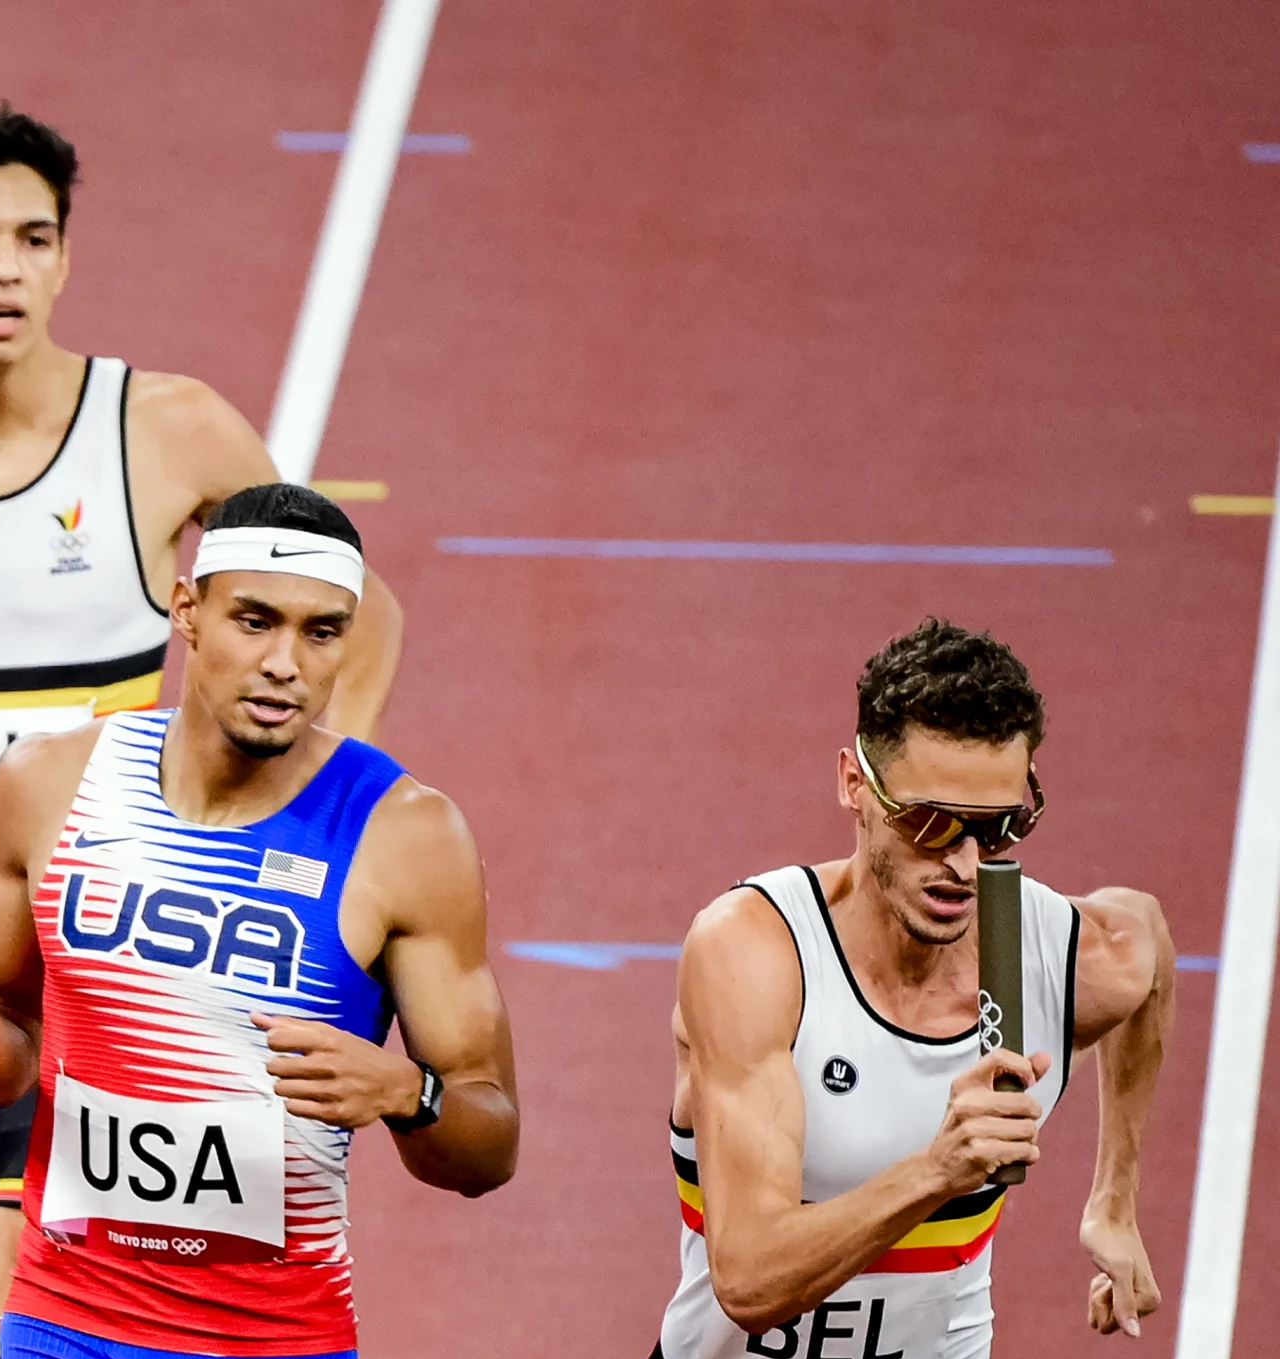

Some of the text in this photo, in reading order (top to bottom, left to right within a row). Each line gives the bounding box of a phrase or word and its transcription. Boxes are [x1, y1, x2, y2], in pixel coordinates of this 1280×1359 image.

[60, 872, 301, 990] USA
[79, 1104, 244, 1205] USA
[107, 1229, 169, 1251] TOKYO 2020
